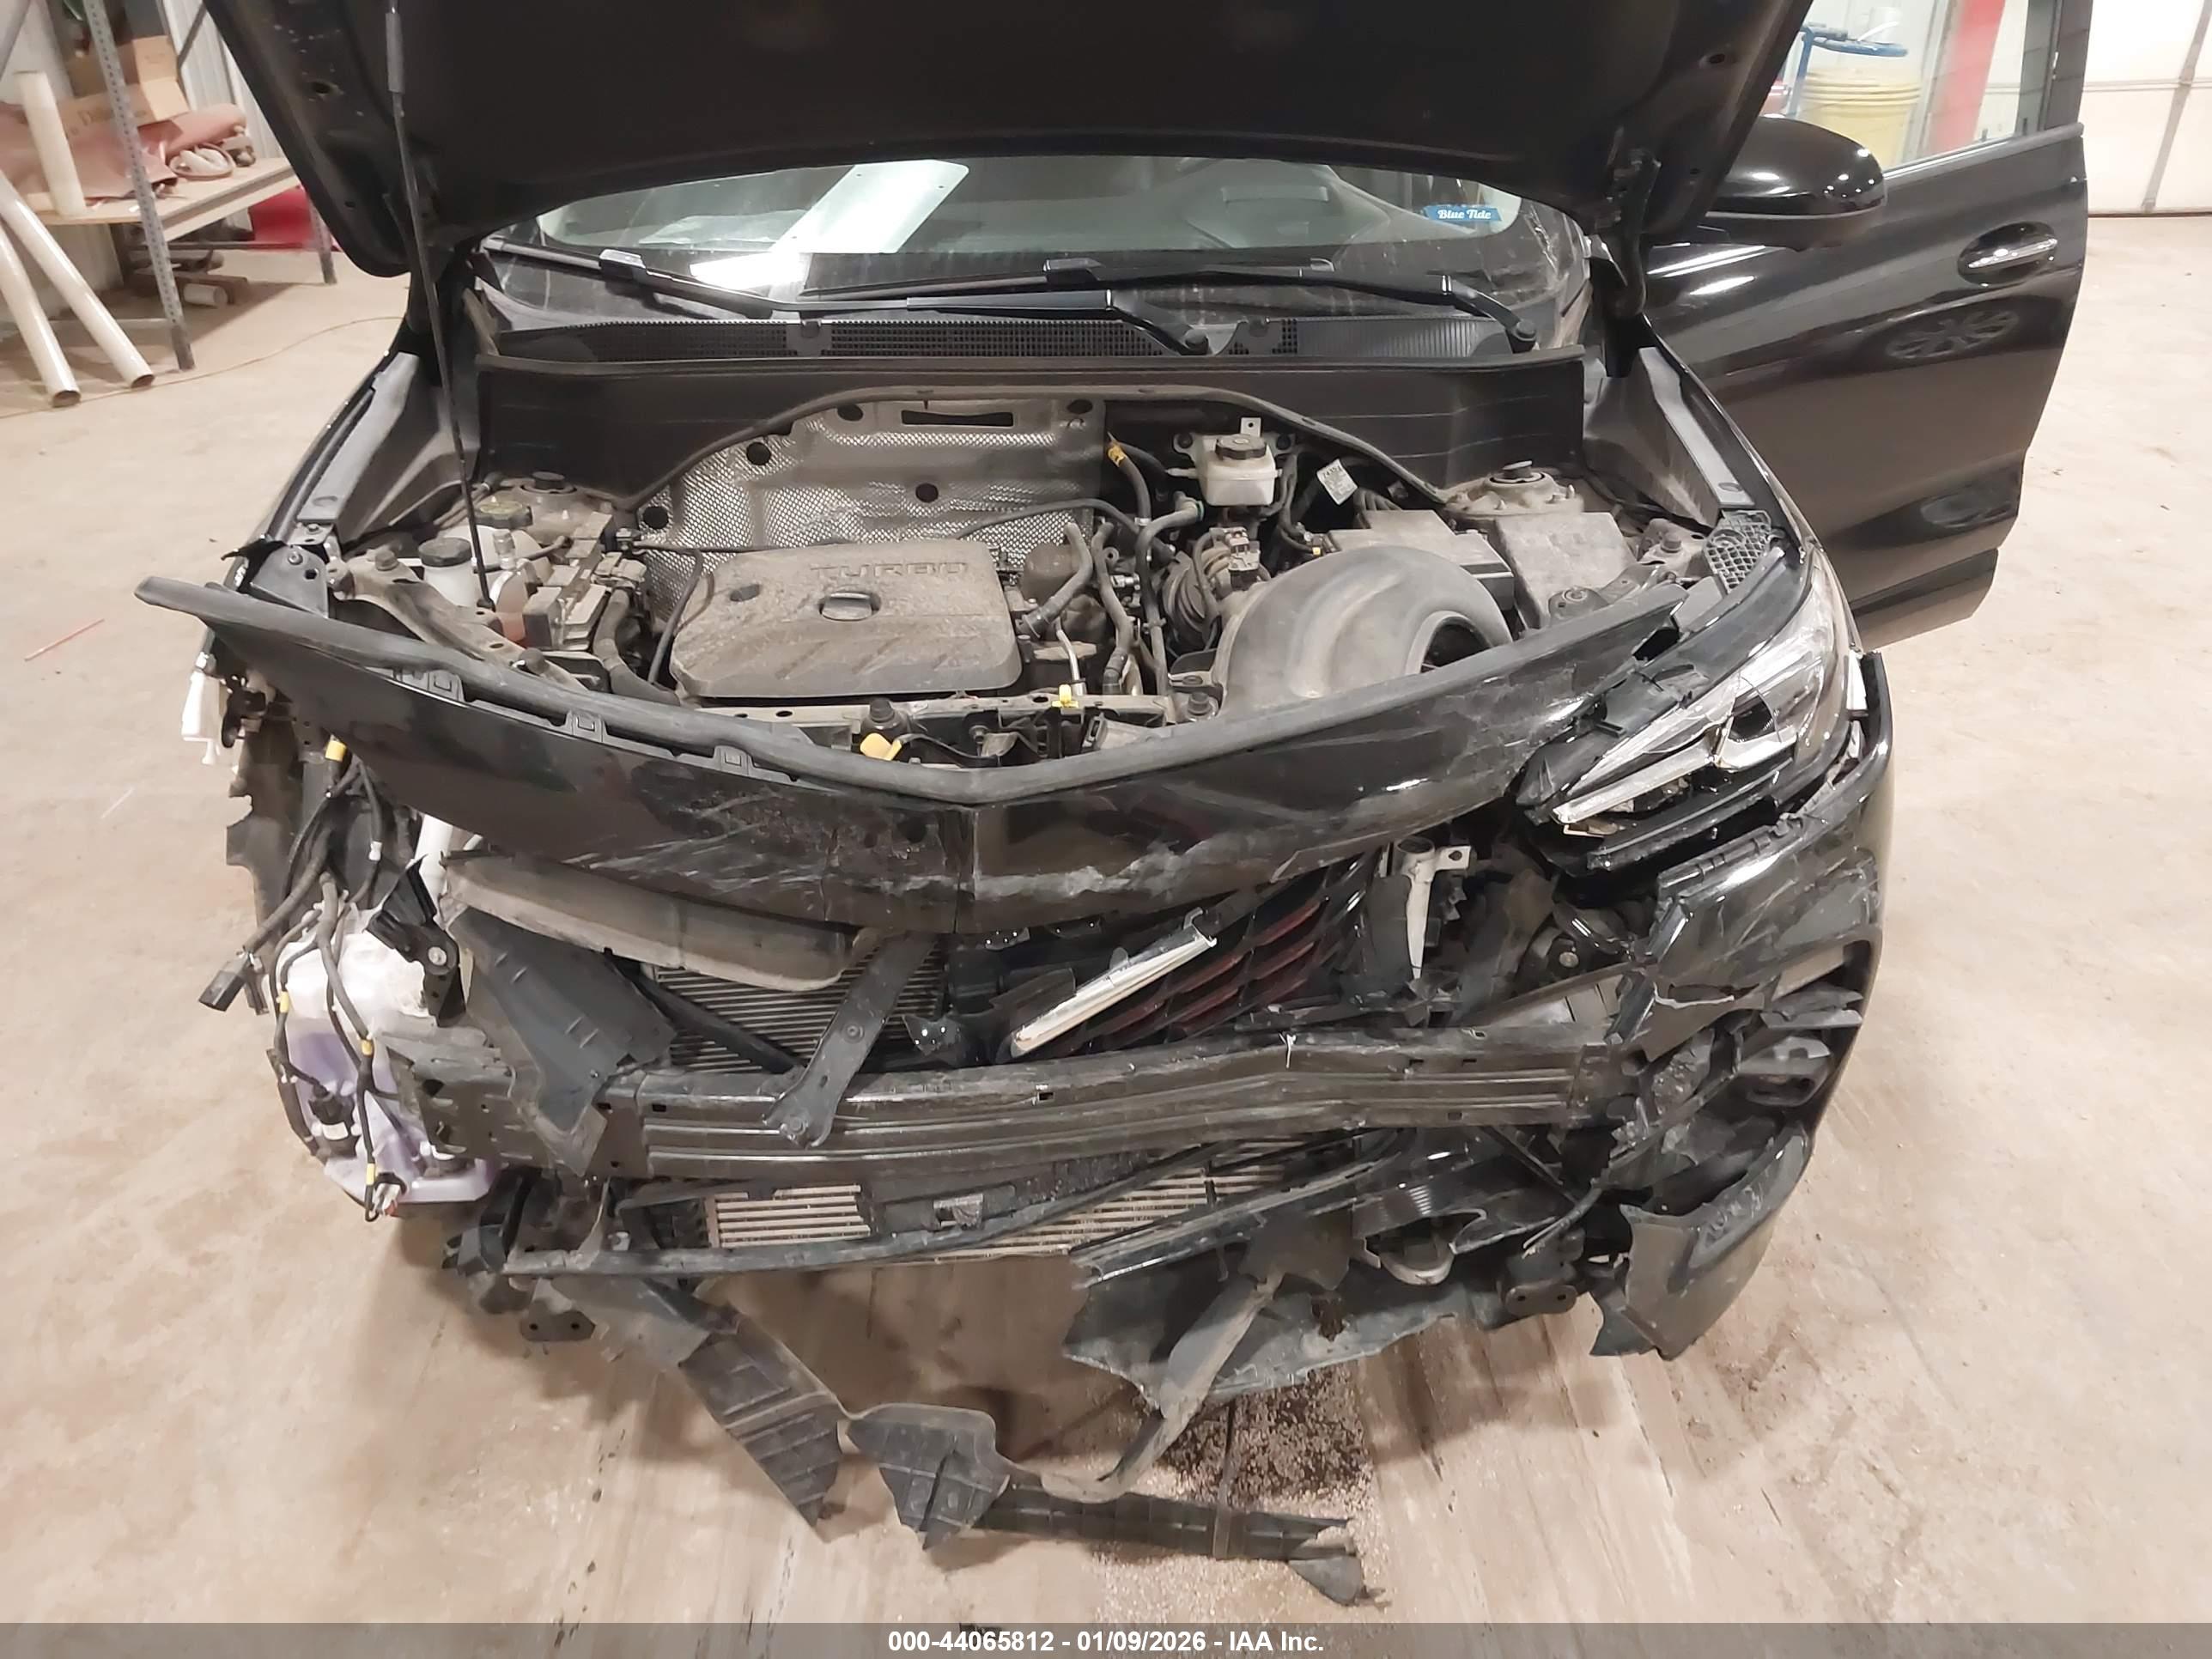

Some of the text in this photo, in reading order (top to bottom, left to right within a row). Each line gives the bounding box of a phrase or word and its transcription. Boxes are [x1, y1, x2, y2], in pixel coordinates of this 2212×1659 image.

[1437, 209, 1492, 220] Blue Tide
[810, 562, 968, 580] TURBO
